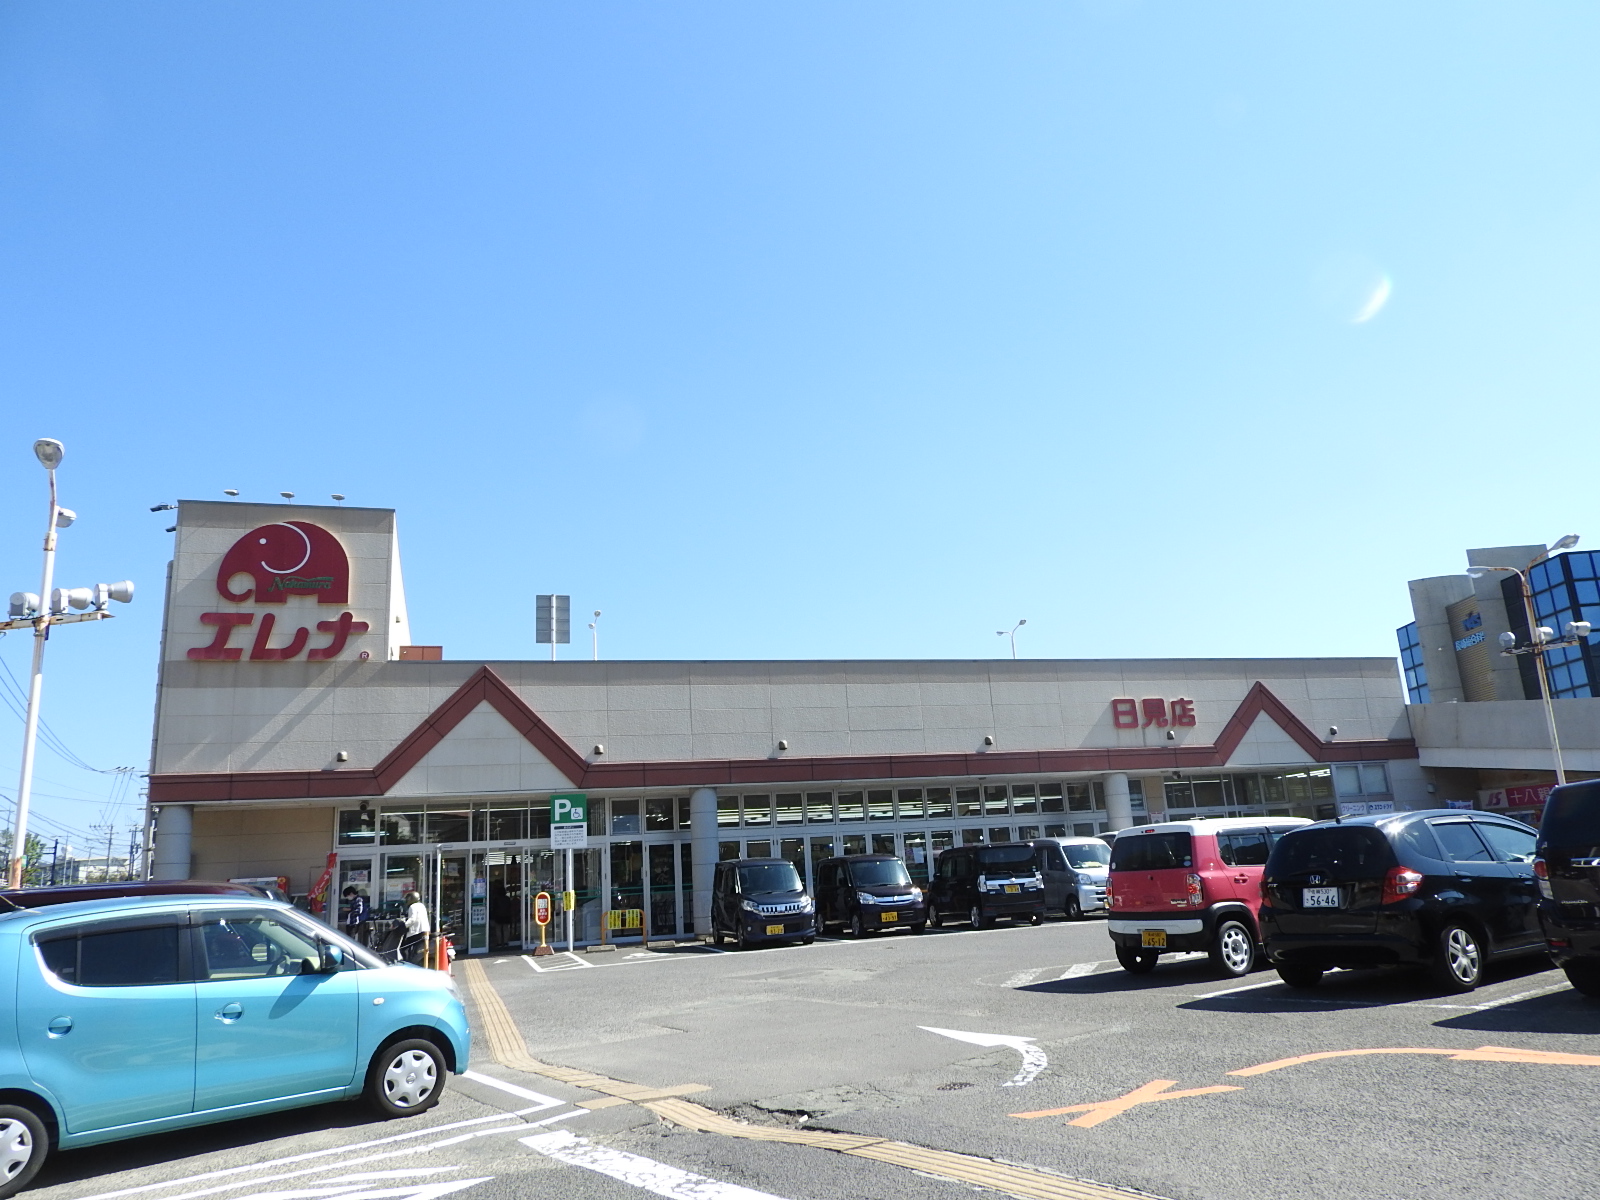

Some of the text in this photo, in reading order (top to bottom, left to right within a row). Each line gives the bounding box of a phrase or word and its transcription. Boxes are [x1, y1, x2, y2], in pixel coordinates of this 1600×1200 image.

[267, 576, 333, 592] Nakamura
[187, 612, 369, 661] エレナ
[1112, 698, 1196, 728] 日見店
[555, 799, 571, 821] P
[1311, 895, 1336, 906] 56-46
